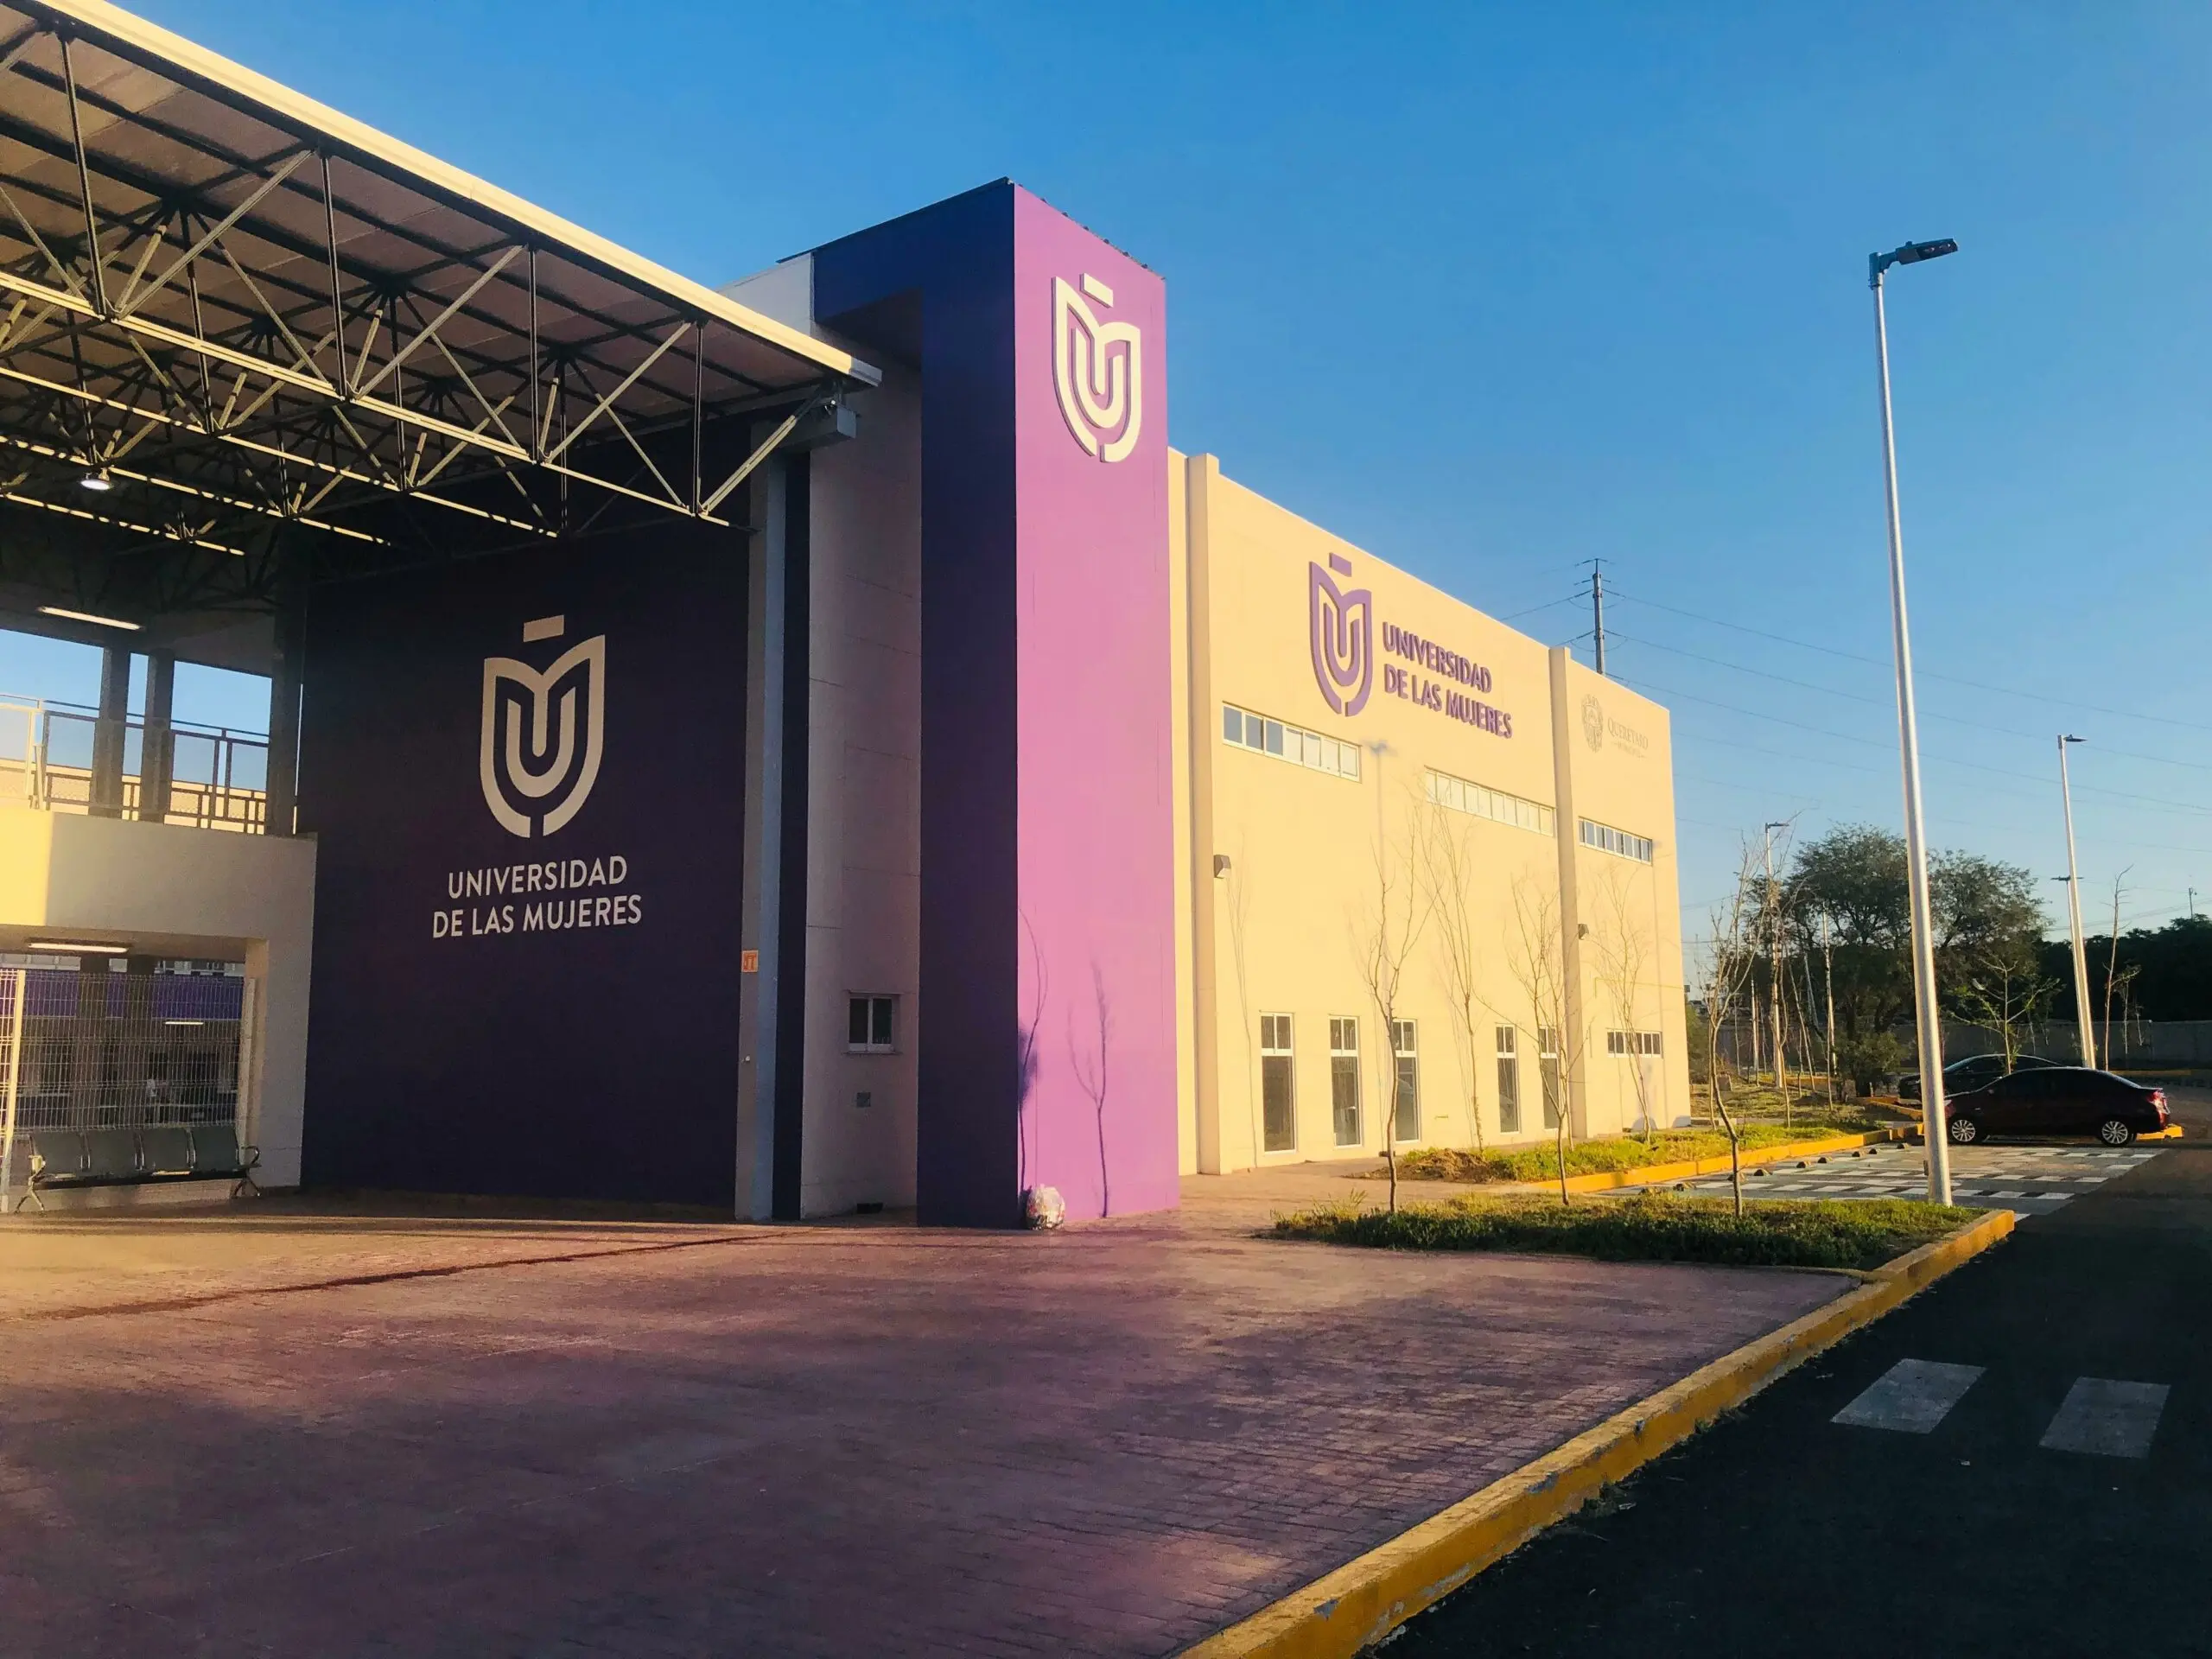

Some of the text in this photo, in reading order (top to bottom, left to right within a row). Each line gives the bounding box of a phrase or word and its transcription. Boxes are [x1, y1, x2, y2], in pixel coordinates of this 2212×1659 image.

[1382, 621, 1492, 694] UNIVERSIDAD
[1383, 664, 1512, 739] DE LAS MUJERES
[448, 855, 627, 899] UNIVERSIDAD
[433, 894, 642, 938] DE LAS MUJERES
